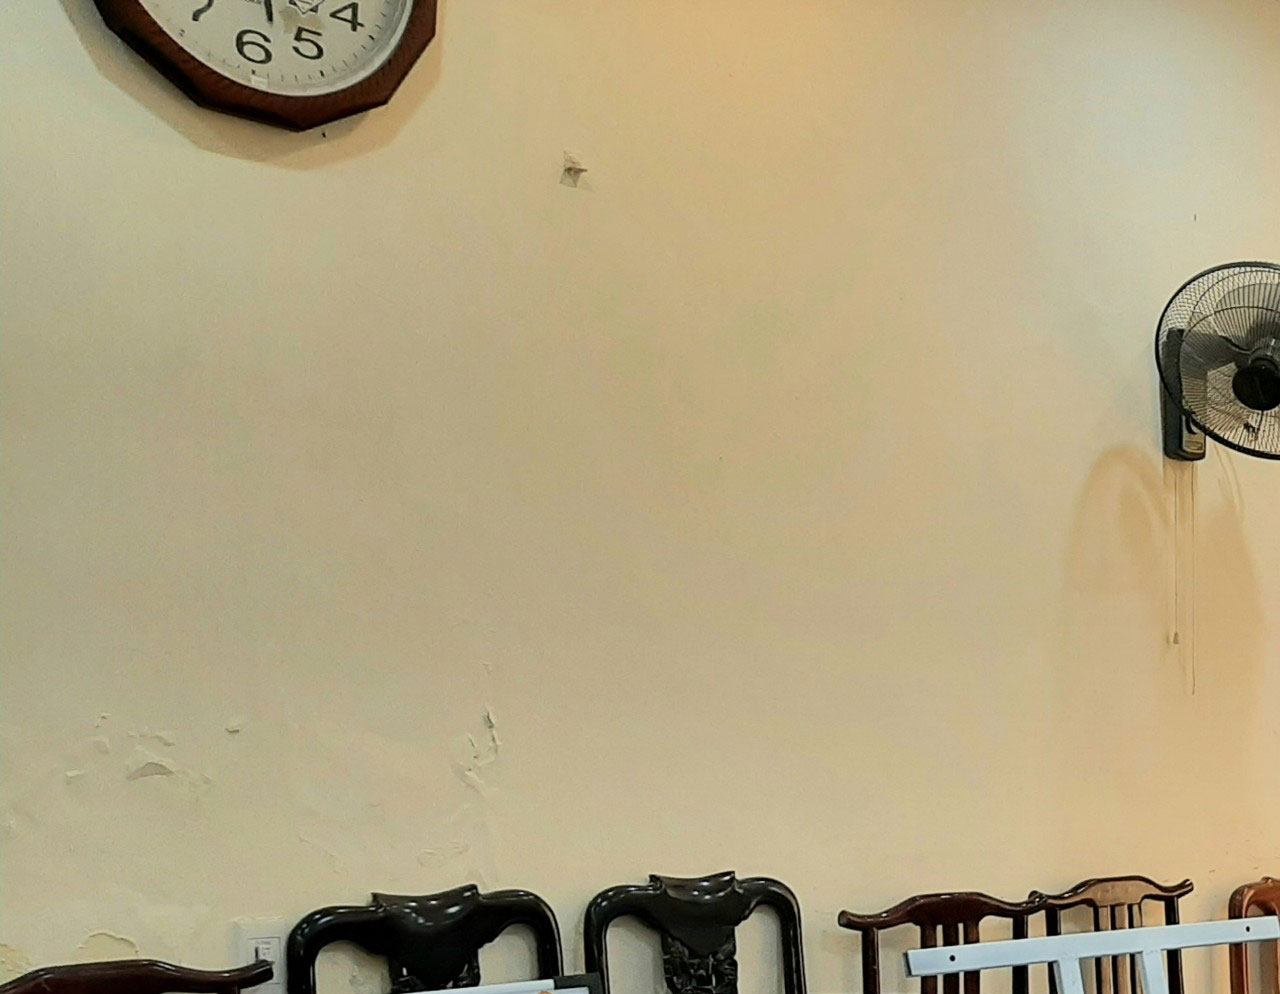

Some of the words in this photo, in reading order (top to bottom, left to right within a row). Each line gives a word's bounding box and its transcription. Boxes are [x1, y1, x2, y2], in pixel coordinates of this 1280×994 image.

[329, 2, 365, 32] 4
[235, 29, 273, 65] 6
[292, 26, 325, 60] 5
